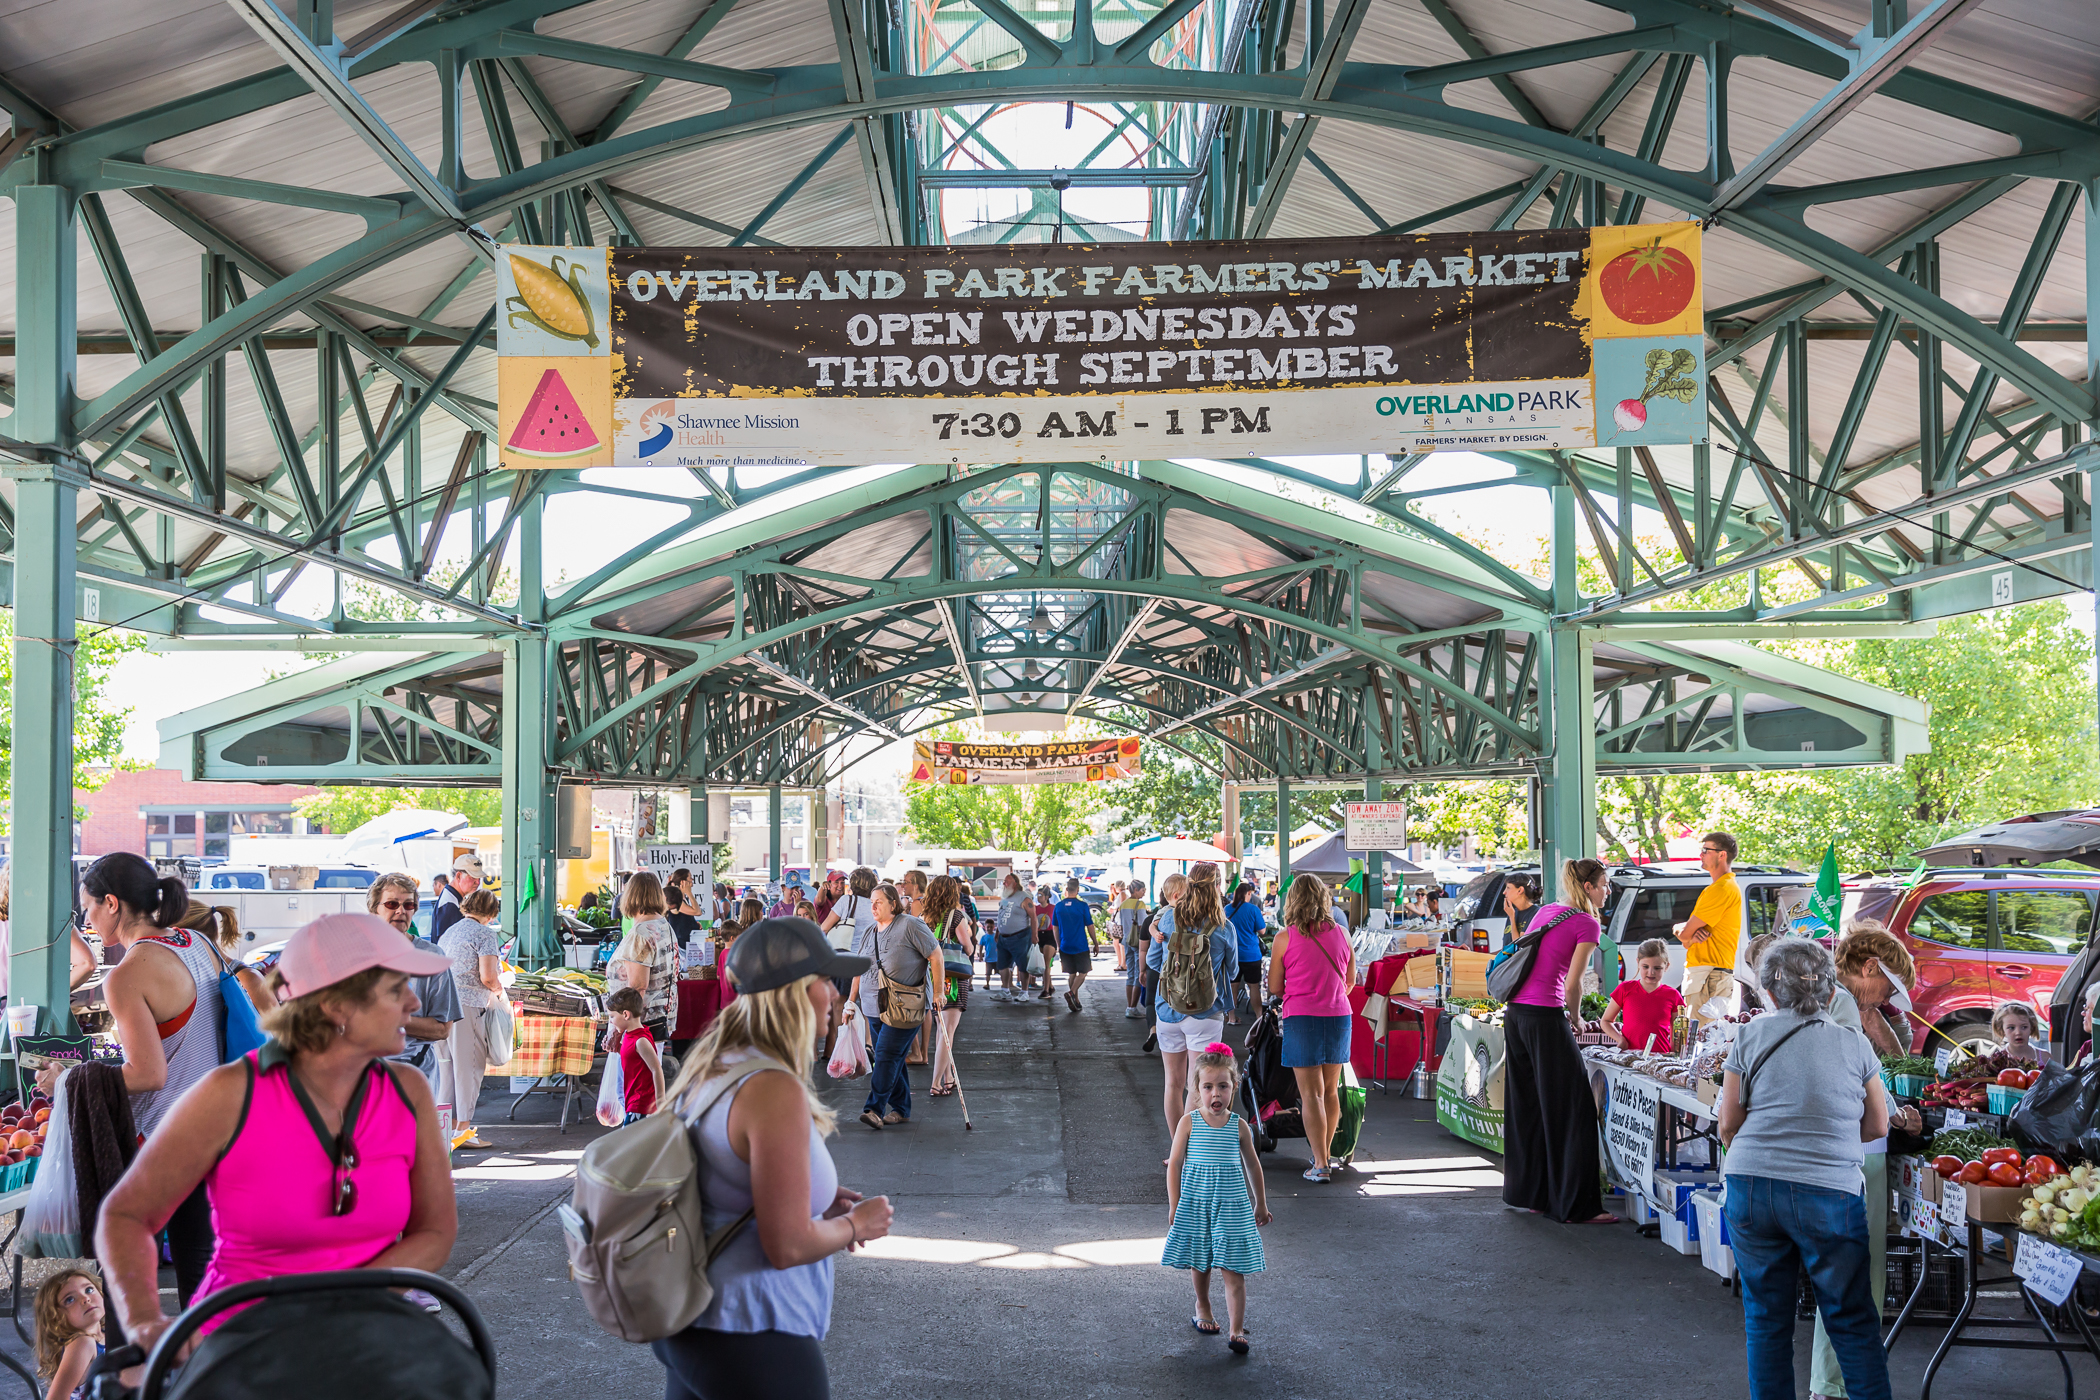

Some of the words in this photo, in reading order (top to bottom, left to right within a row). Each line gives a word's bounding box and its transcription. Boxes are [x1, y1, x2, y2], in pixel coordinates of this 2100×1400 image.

[627, 268, 907, 302] OVERLAND
[923, 267, 1068, 299] PARK
[1082, 260, 1341, 296] FARMERS'
[1357, 251, 1580, 289] MARKET
[846, 312, 984, 347] OPEN
[1002, 304, 1358, 344] WEDNESDAYS
[807, 353, 1060, 388] THROUGH
[1080, 345, 1399, 385] SEPTEMBER
[1375, 393, 1515, 416] OVERLAND
[1518, 389, 1582, 411] PARK
[677, 414, 741, 429] Shawnee
[744, 414, 800, 429] Mission
[932, 411, 1022, 440] 7:30
[1037, 410, 1118, 438] AM
[1166, 409, 1185, 436] 1
[1200, 406, 1272, 435] PM
[678, 430, 725, 446] Health
[1415, 437, 1457, 446] FARMERS'
[1458, 436, 1497, 445] MARKET.
[1512, 434, 1549, 443] DESIGN.
[677, 456, 702, 466] Much
[706, 458, 730, 466] more
[733, 456, 755, 466] than
[757, 455, 802, 466] medicine.
[1996, 577, 2010, 600] 45
[87, 593, 97, 617] 18
[935, 754, 1030, 770] FARMERS'
[1035, 750, 1119, 769] MARKET
[959, 744, 1043, 757] OVERLAND
[1047, 743, 1089, 755] PARK
[1348, 804, 1361, 813] TOW
[1364, 804, 1382, 813] AWAY
[1386, 803, 1403, 813] ZONE
[650, 849, 710, 868] Holy-Field
[1812, 889, 1836, 922] GROWN
[1437, 1095, 1469, 1127] GREN
